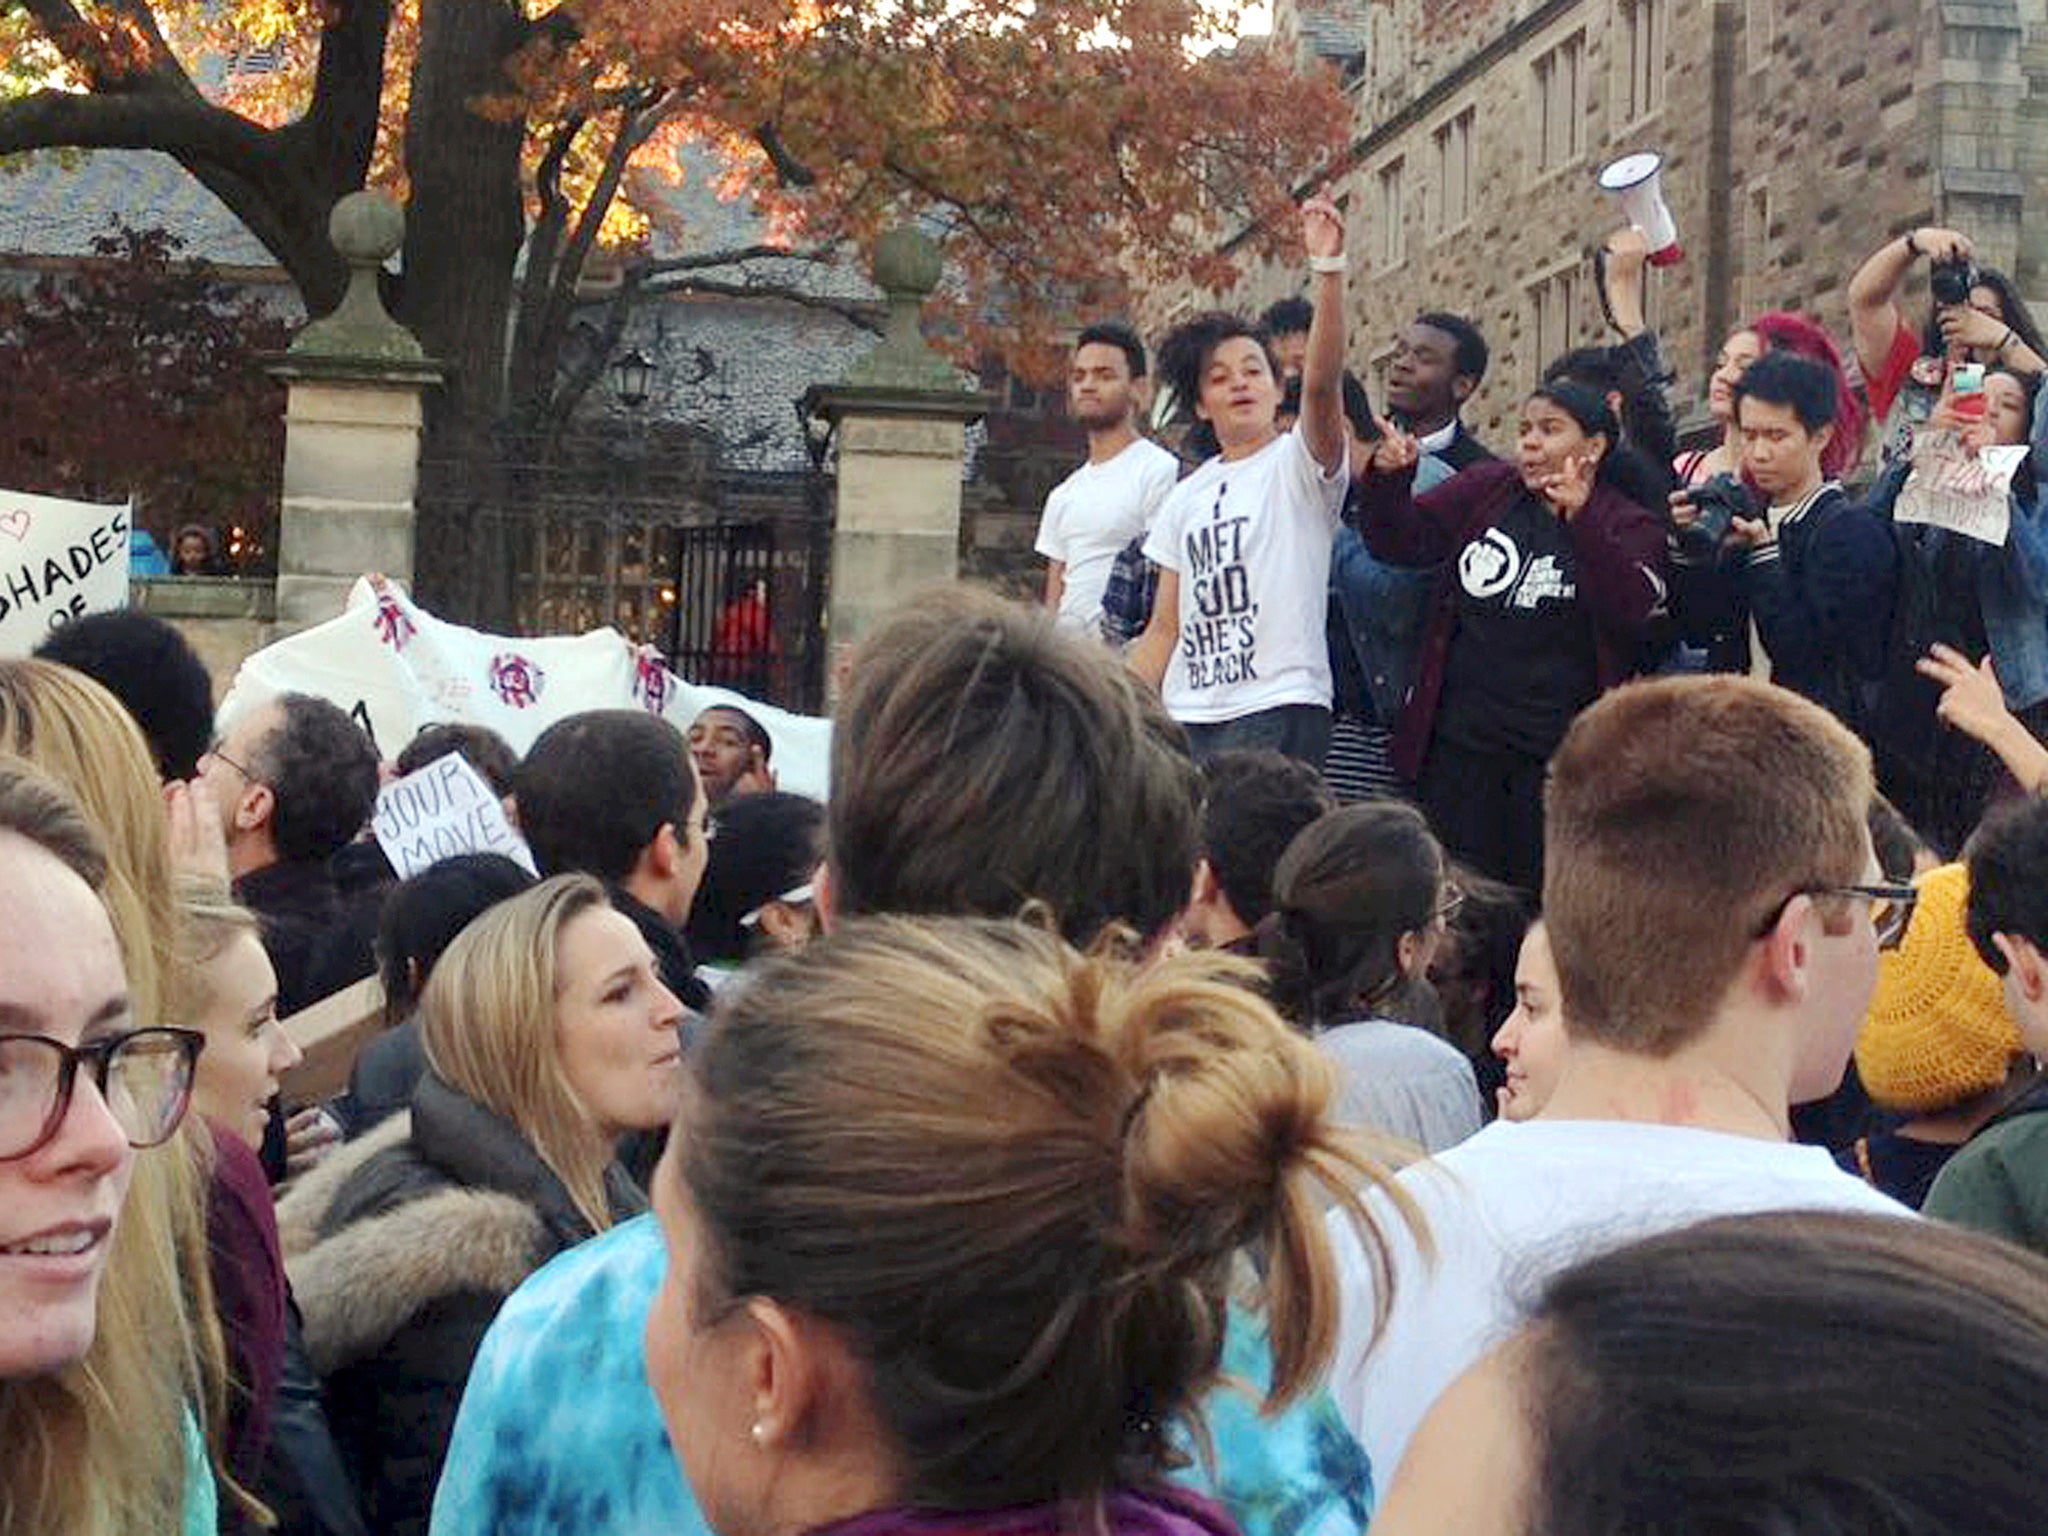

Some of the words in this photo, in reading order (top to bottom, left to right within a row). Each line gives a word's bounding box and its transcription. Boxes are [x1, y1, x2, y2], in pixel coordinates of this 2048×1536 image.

[1182, 614, 1256, 659] SHE'S
[1186, 651, 1259, 691] BLACK
[400, 800, 506, 879] MOVE
